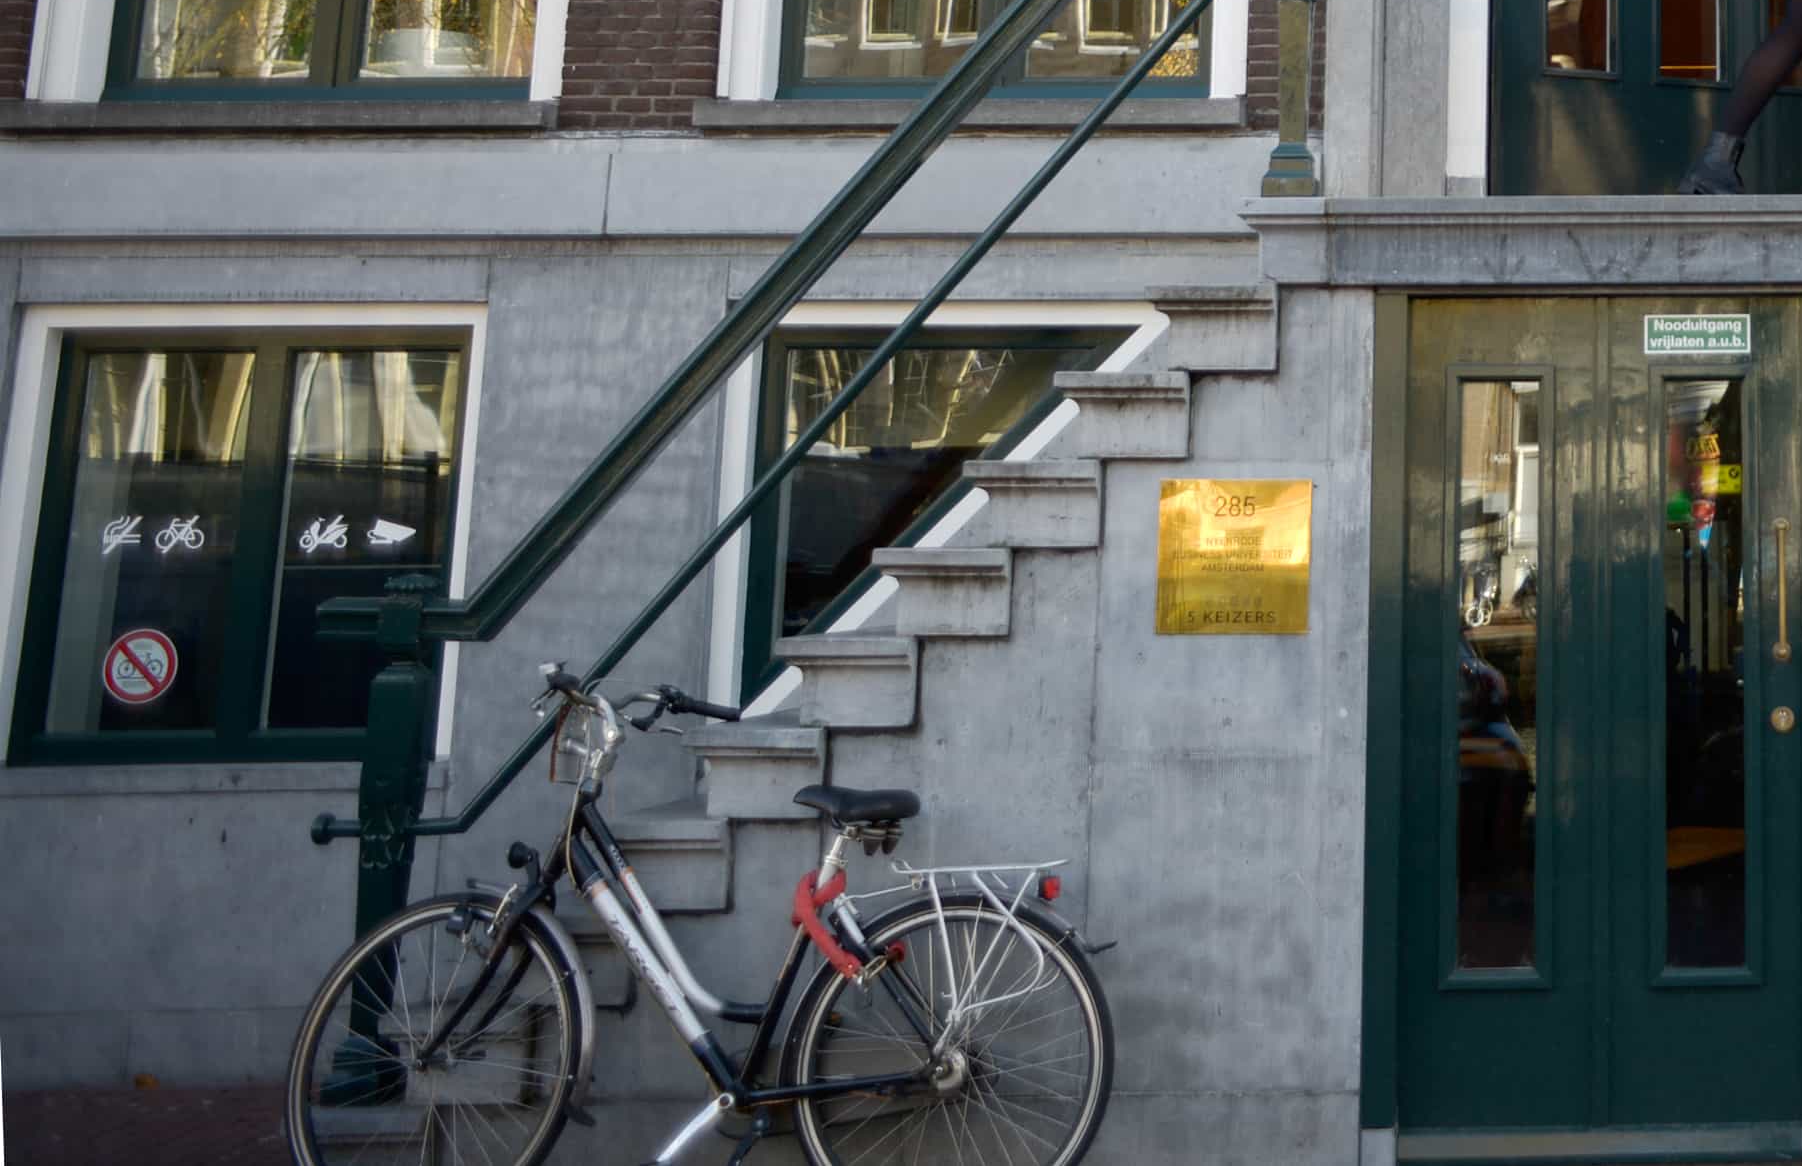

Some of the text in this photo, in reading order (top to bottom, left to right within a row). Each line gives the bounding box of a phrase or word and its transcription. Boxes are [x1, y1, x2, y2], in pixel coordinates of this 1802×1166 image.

[1653, 318, 1742, 333] Nooduitgang
[1650, 334, 1746, 349] vrijlaten a.u.b.
[1188, 611, 1276, 623] 5 KEIZERS
